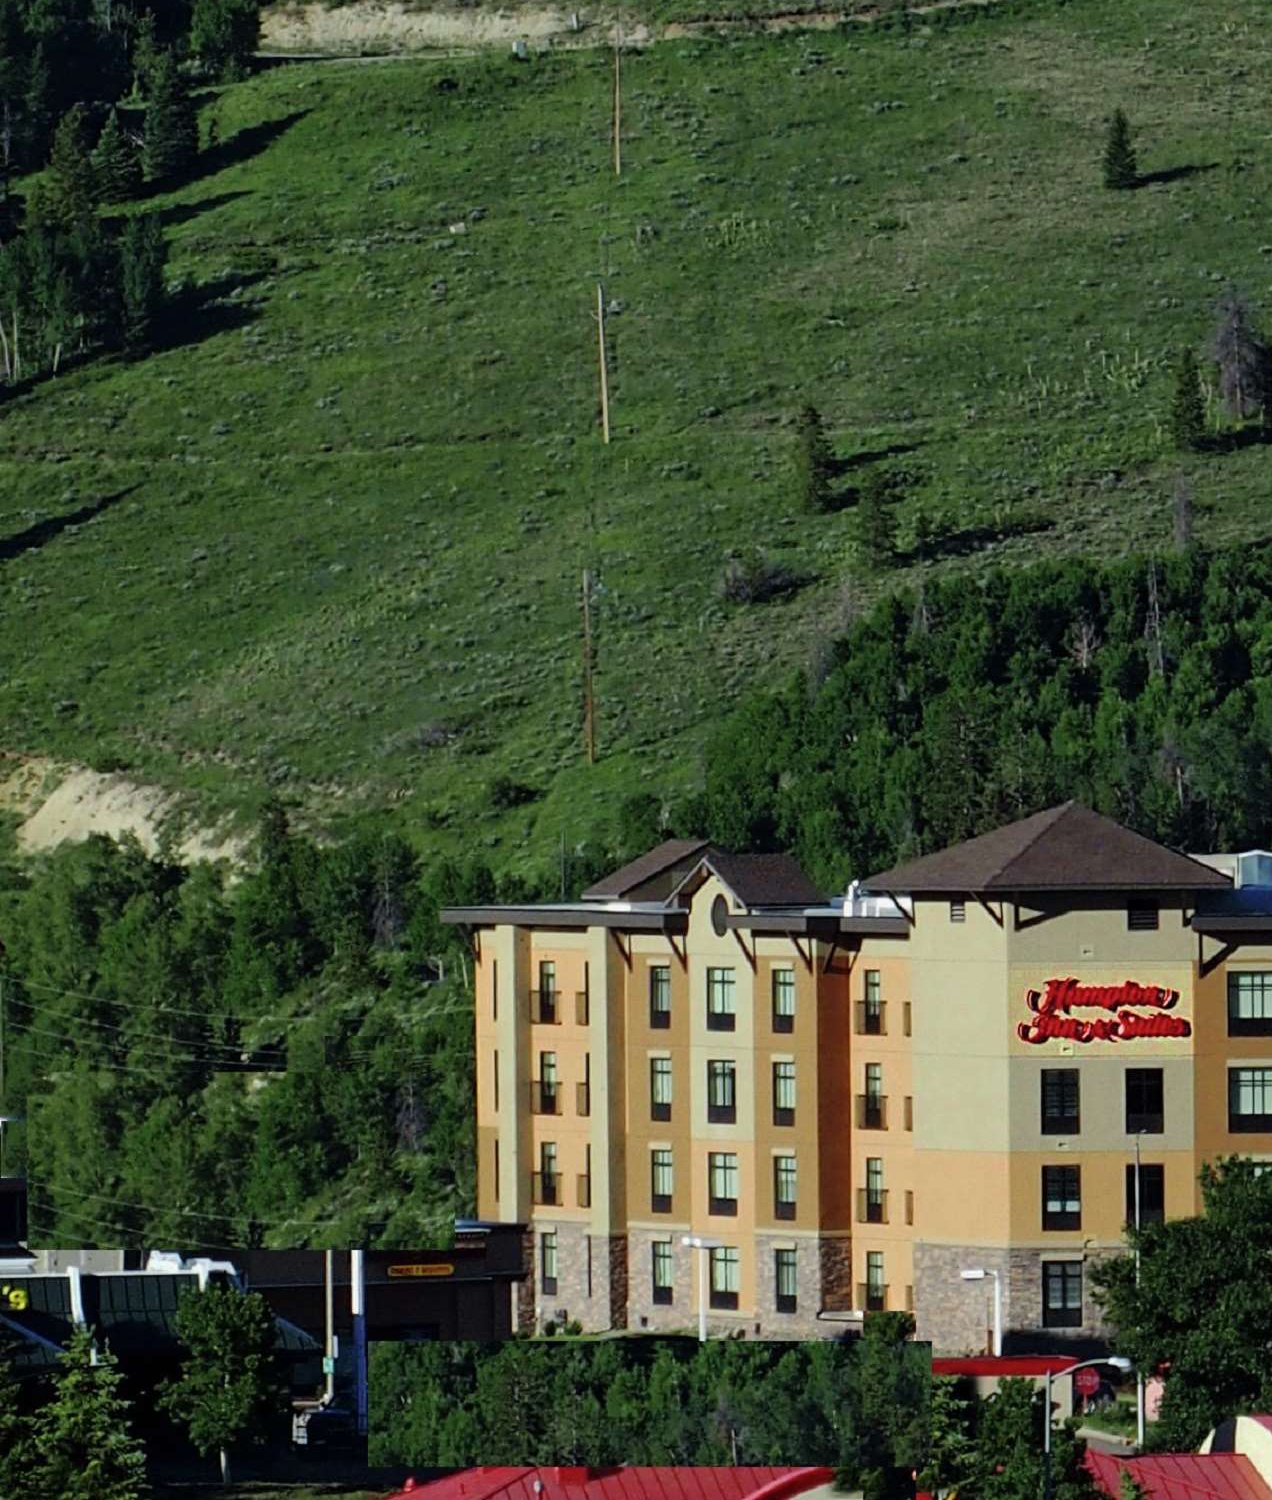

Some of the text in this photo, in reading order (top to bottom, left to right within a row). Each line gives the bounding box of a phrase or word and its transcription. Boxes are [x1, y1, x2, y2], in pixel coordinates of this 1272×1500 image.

[1027, 977, 1180, 1015] Hampton
[1018, 1015, 1094, 1044] Inn
[1118, 1010, 1192, 1040] Suites
